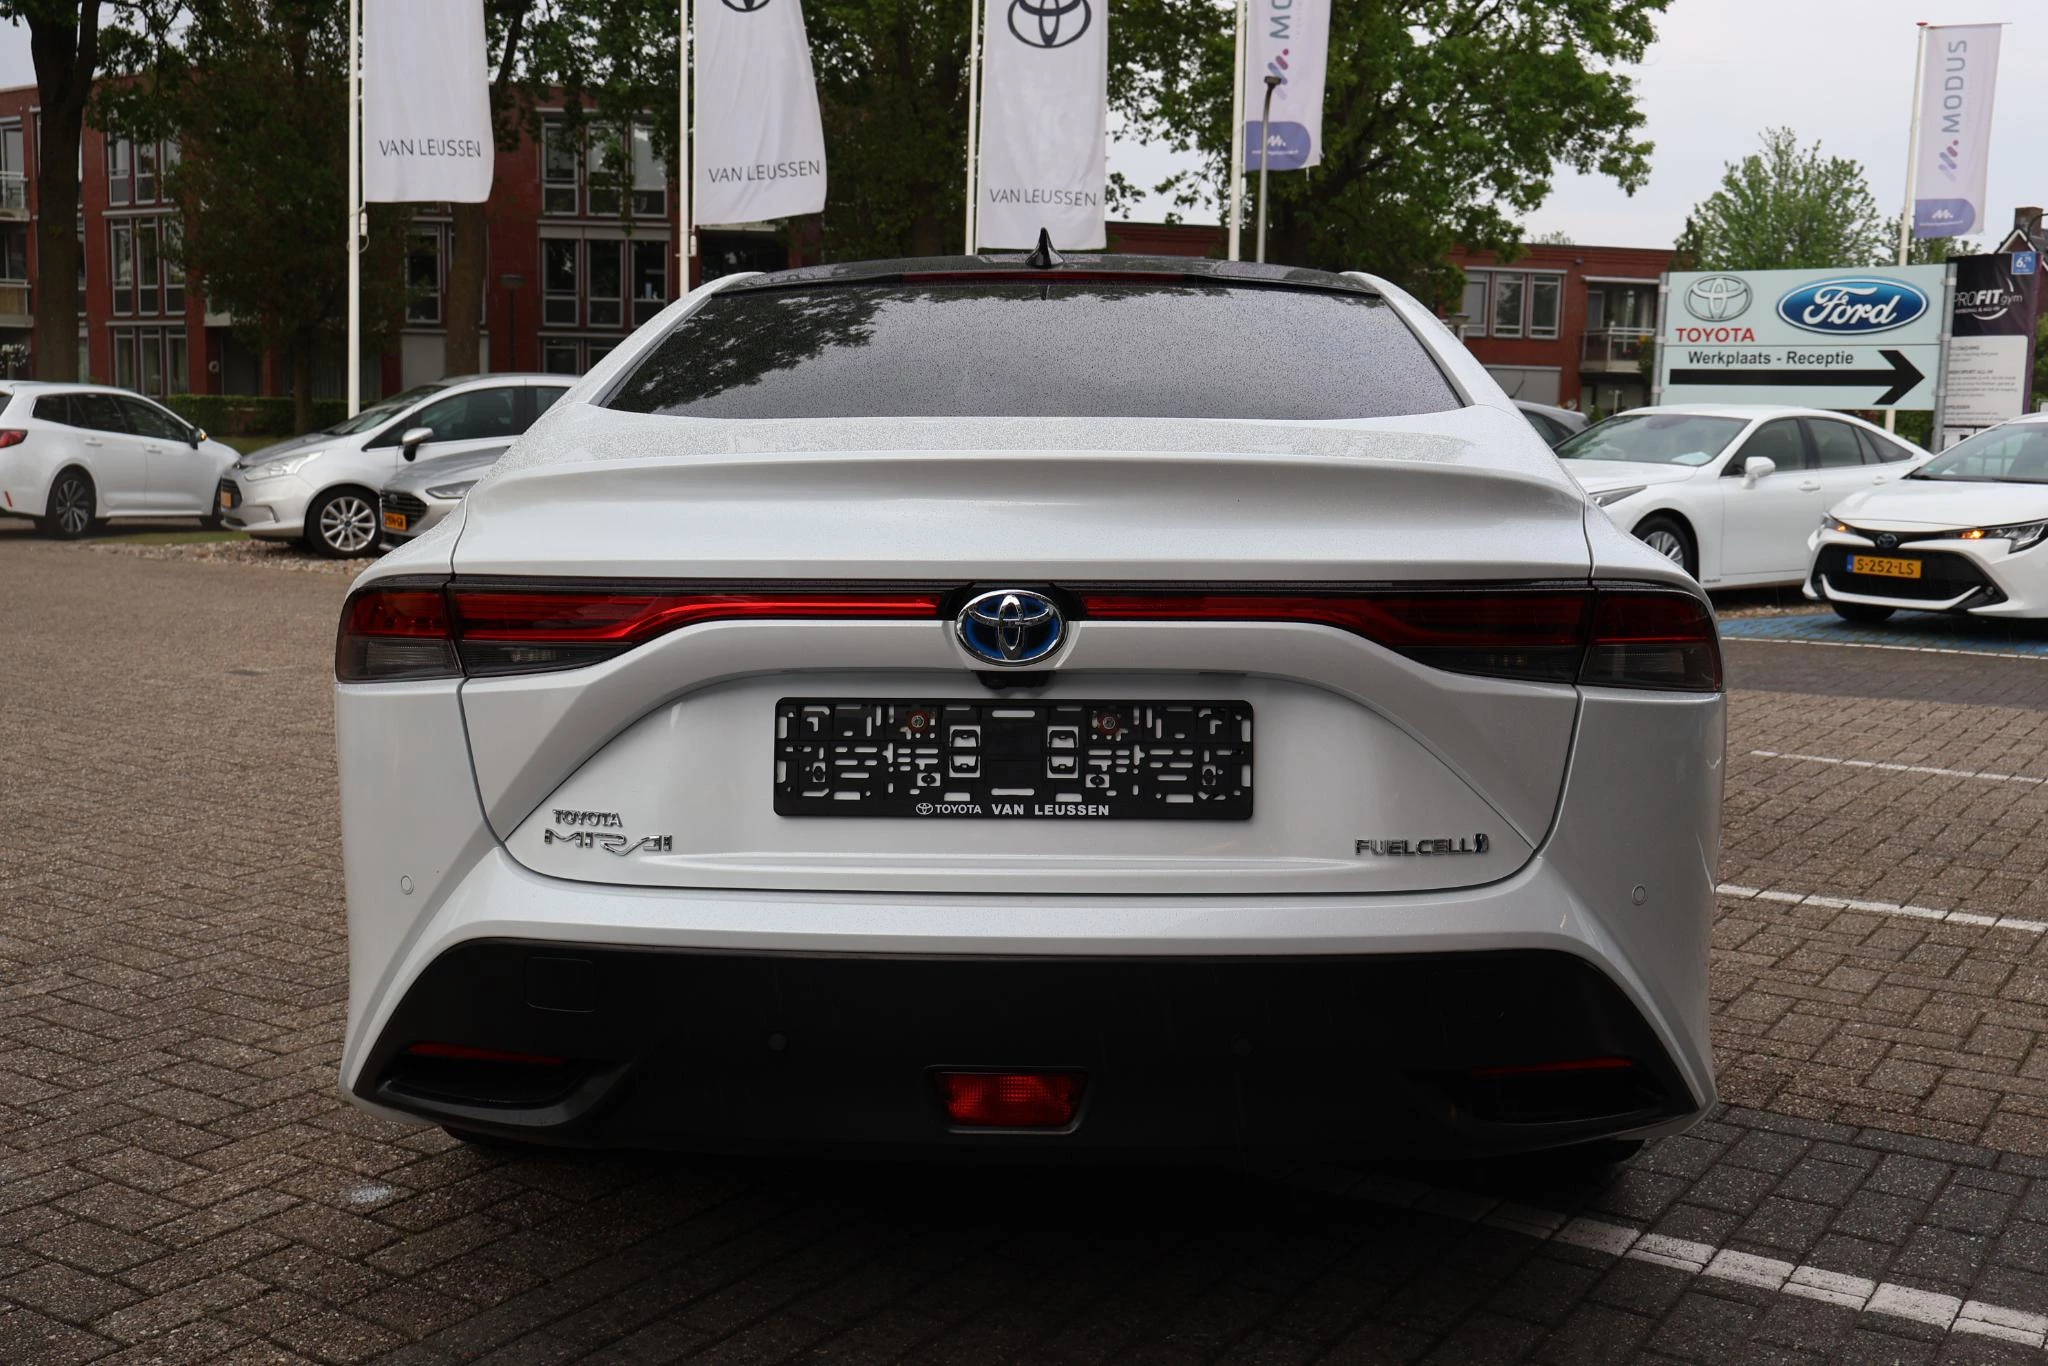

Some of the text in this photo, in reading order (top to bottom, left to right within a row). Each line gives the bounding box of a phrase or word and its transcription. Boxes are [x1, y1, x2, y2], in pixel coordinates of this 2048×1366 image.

[1941, 39, 1967, 133] MODUS
[379, 138, 481, 158] VAN LEUSSEN
[708, 160, 820, 183] VAN LEUSSEN
[989, 189, 1097, 206] VAN LEUSSEN
[1802, 286, 1901, 325] Ford
[1676, 327, 1755, 343] TOYOTA
[1688, 350, 1771, 367] Werkplaats
[1786, 350, 1854, 367] Receptie
[553, 809, 623, 828] TOYOTA
[939, 804, 1109, 816] TOYOTA VAN LEUSSEN
